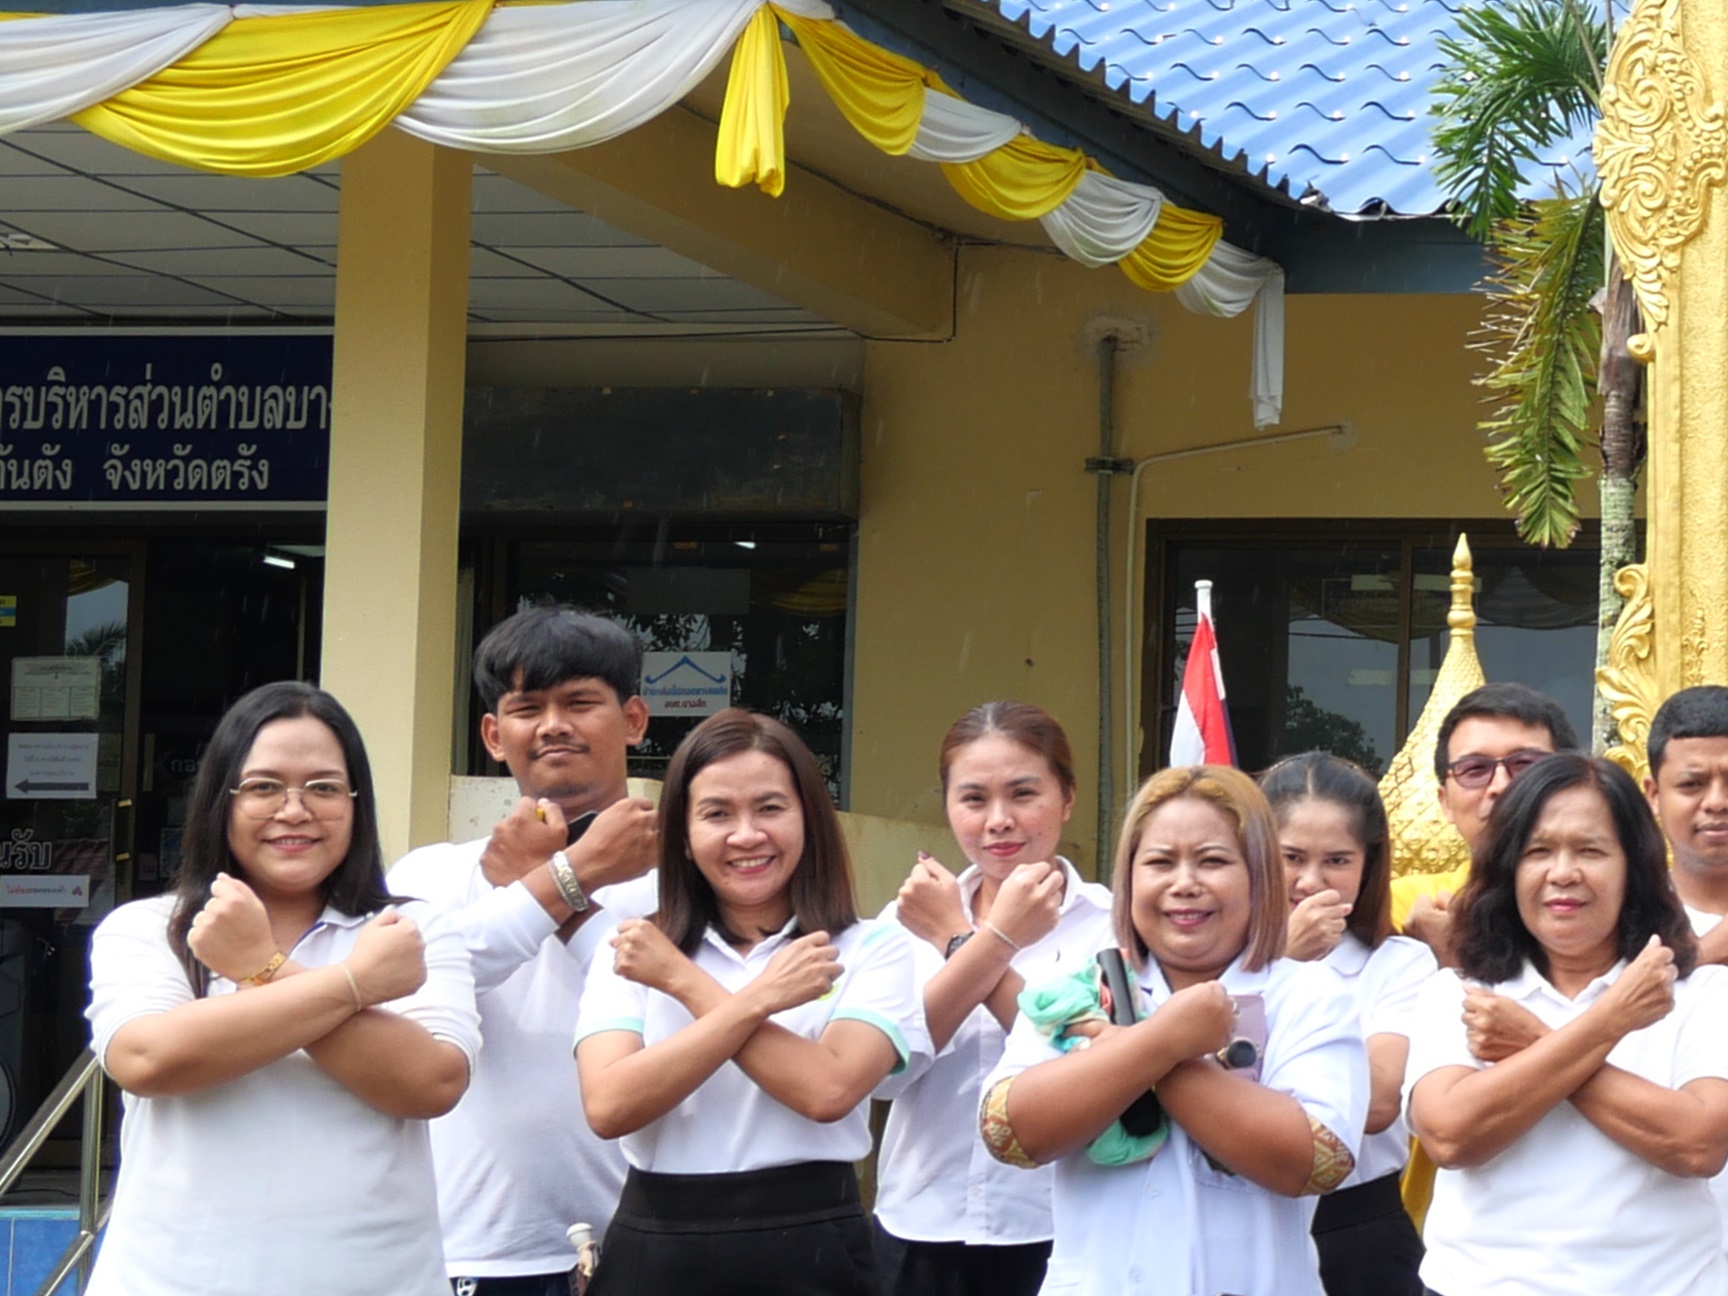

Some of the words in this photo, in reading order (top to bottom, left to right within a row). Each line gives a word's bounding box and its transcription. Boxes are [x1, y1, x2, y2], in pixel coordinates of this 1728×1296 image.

[0, 362, 332, 430] รบริหารส่วนตำบลบา
[102, 443, 270, 491] จังหวัดตรัง
